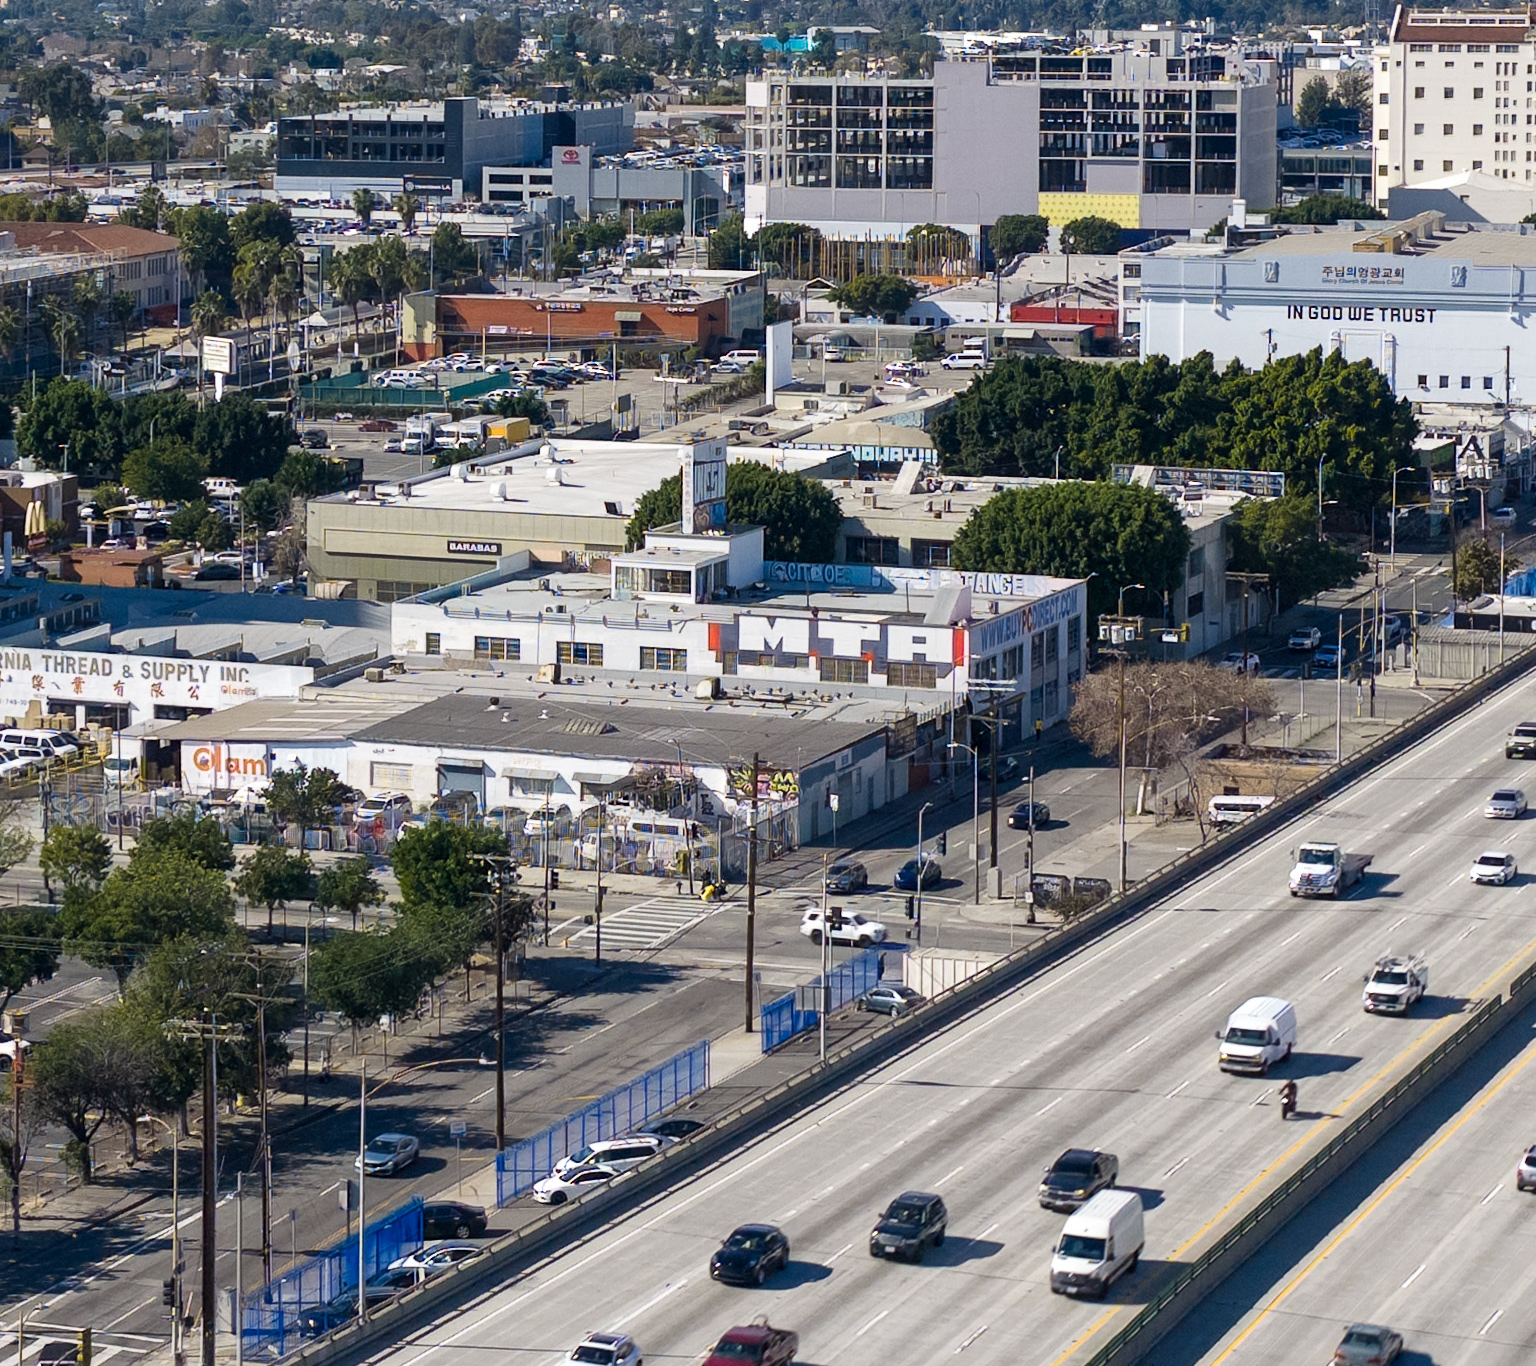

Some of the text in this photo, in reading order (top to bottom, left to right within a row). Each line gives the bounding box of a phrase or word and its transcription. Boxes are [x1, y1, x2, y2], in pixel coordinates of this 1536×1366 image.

[1287, 305, 1437, 324] IN GOD WE TRUST
[449, 542, 498, 553] BARABAS
[42, 654, 113, 677] THREAD
[122, 665, 133, 678] &
[141, 661, 210, 684] SUPPLY
